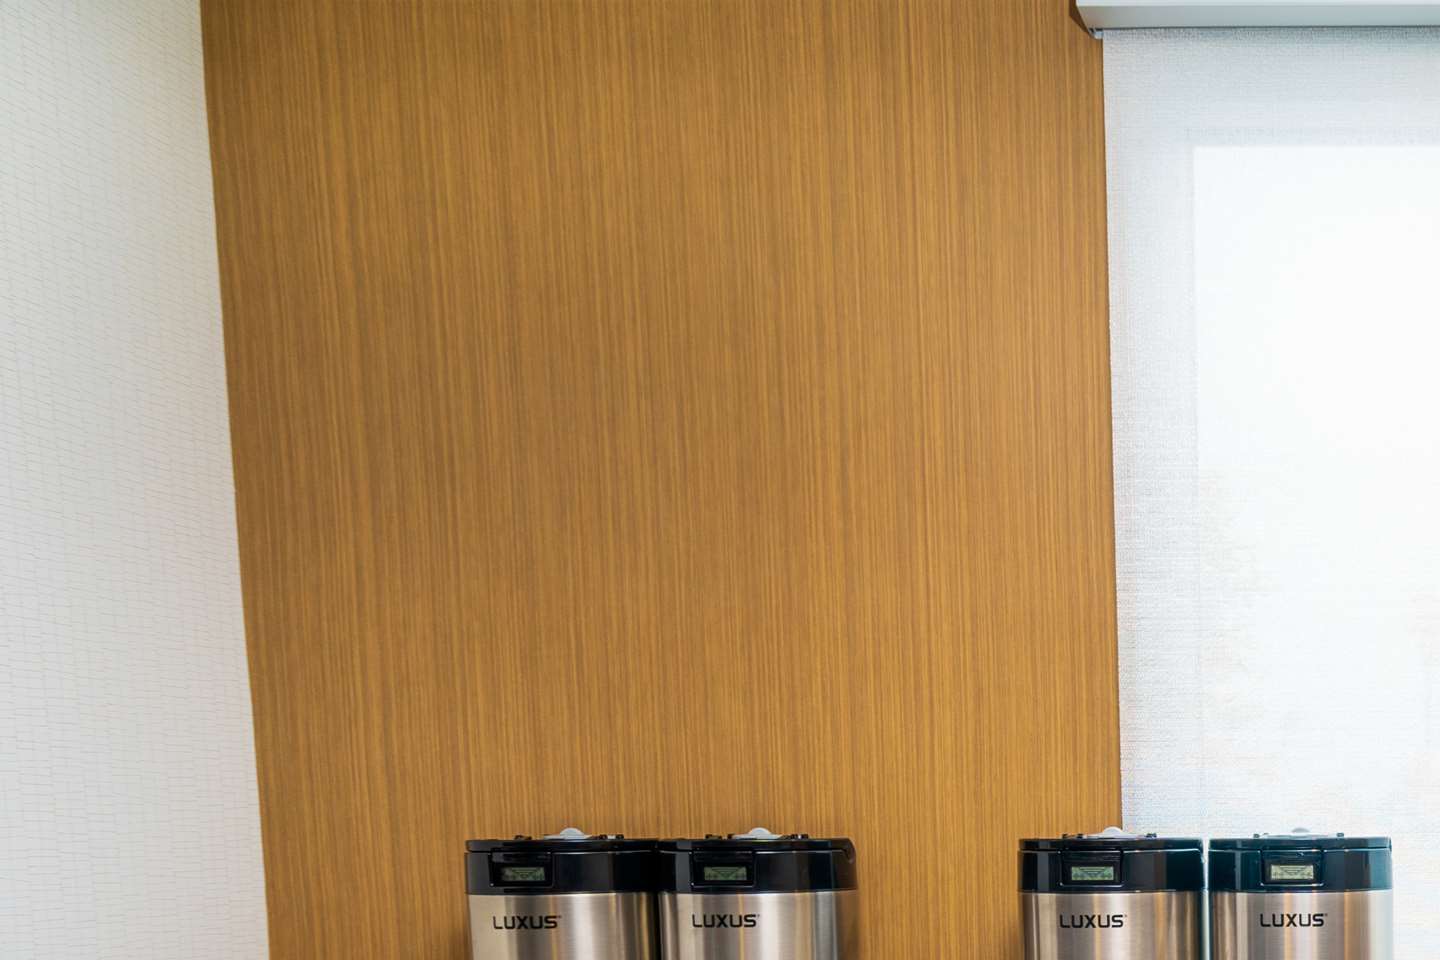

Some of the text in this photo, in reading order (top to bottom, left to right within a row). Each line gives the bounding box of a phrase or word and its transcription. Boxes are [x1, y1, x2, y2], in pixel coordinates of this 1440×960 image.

[492, 915, 558, 930] LUXUS
[692, 914, 757, 928] LUXUS
[1059, 914, 1124, 928] LUXUS
[1260, 913, 1325, 928] LUXUS
